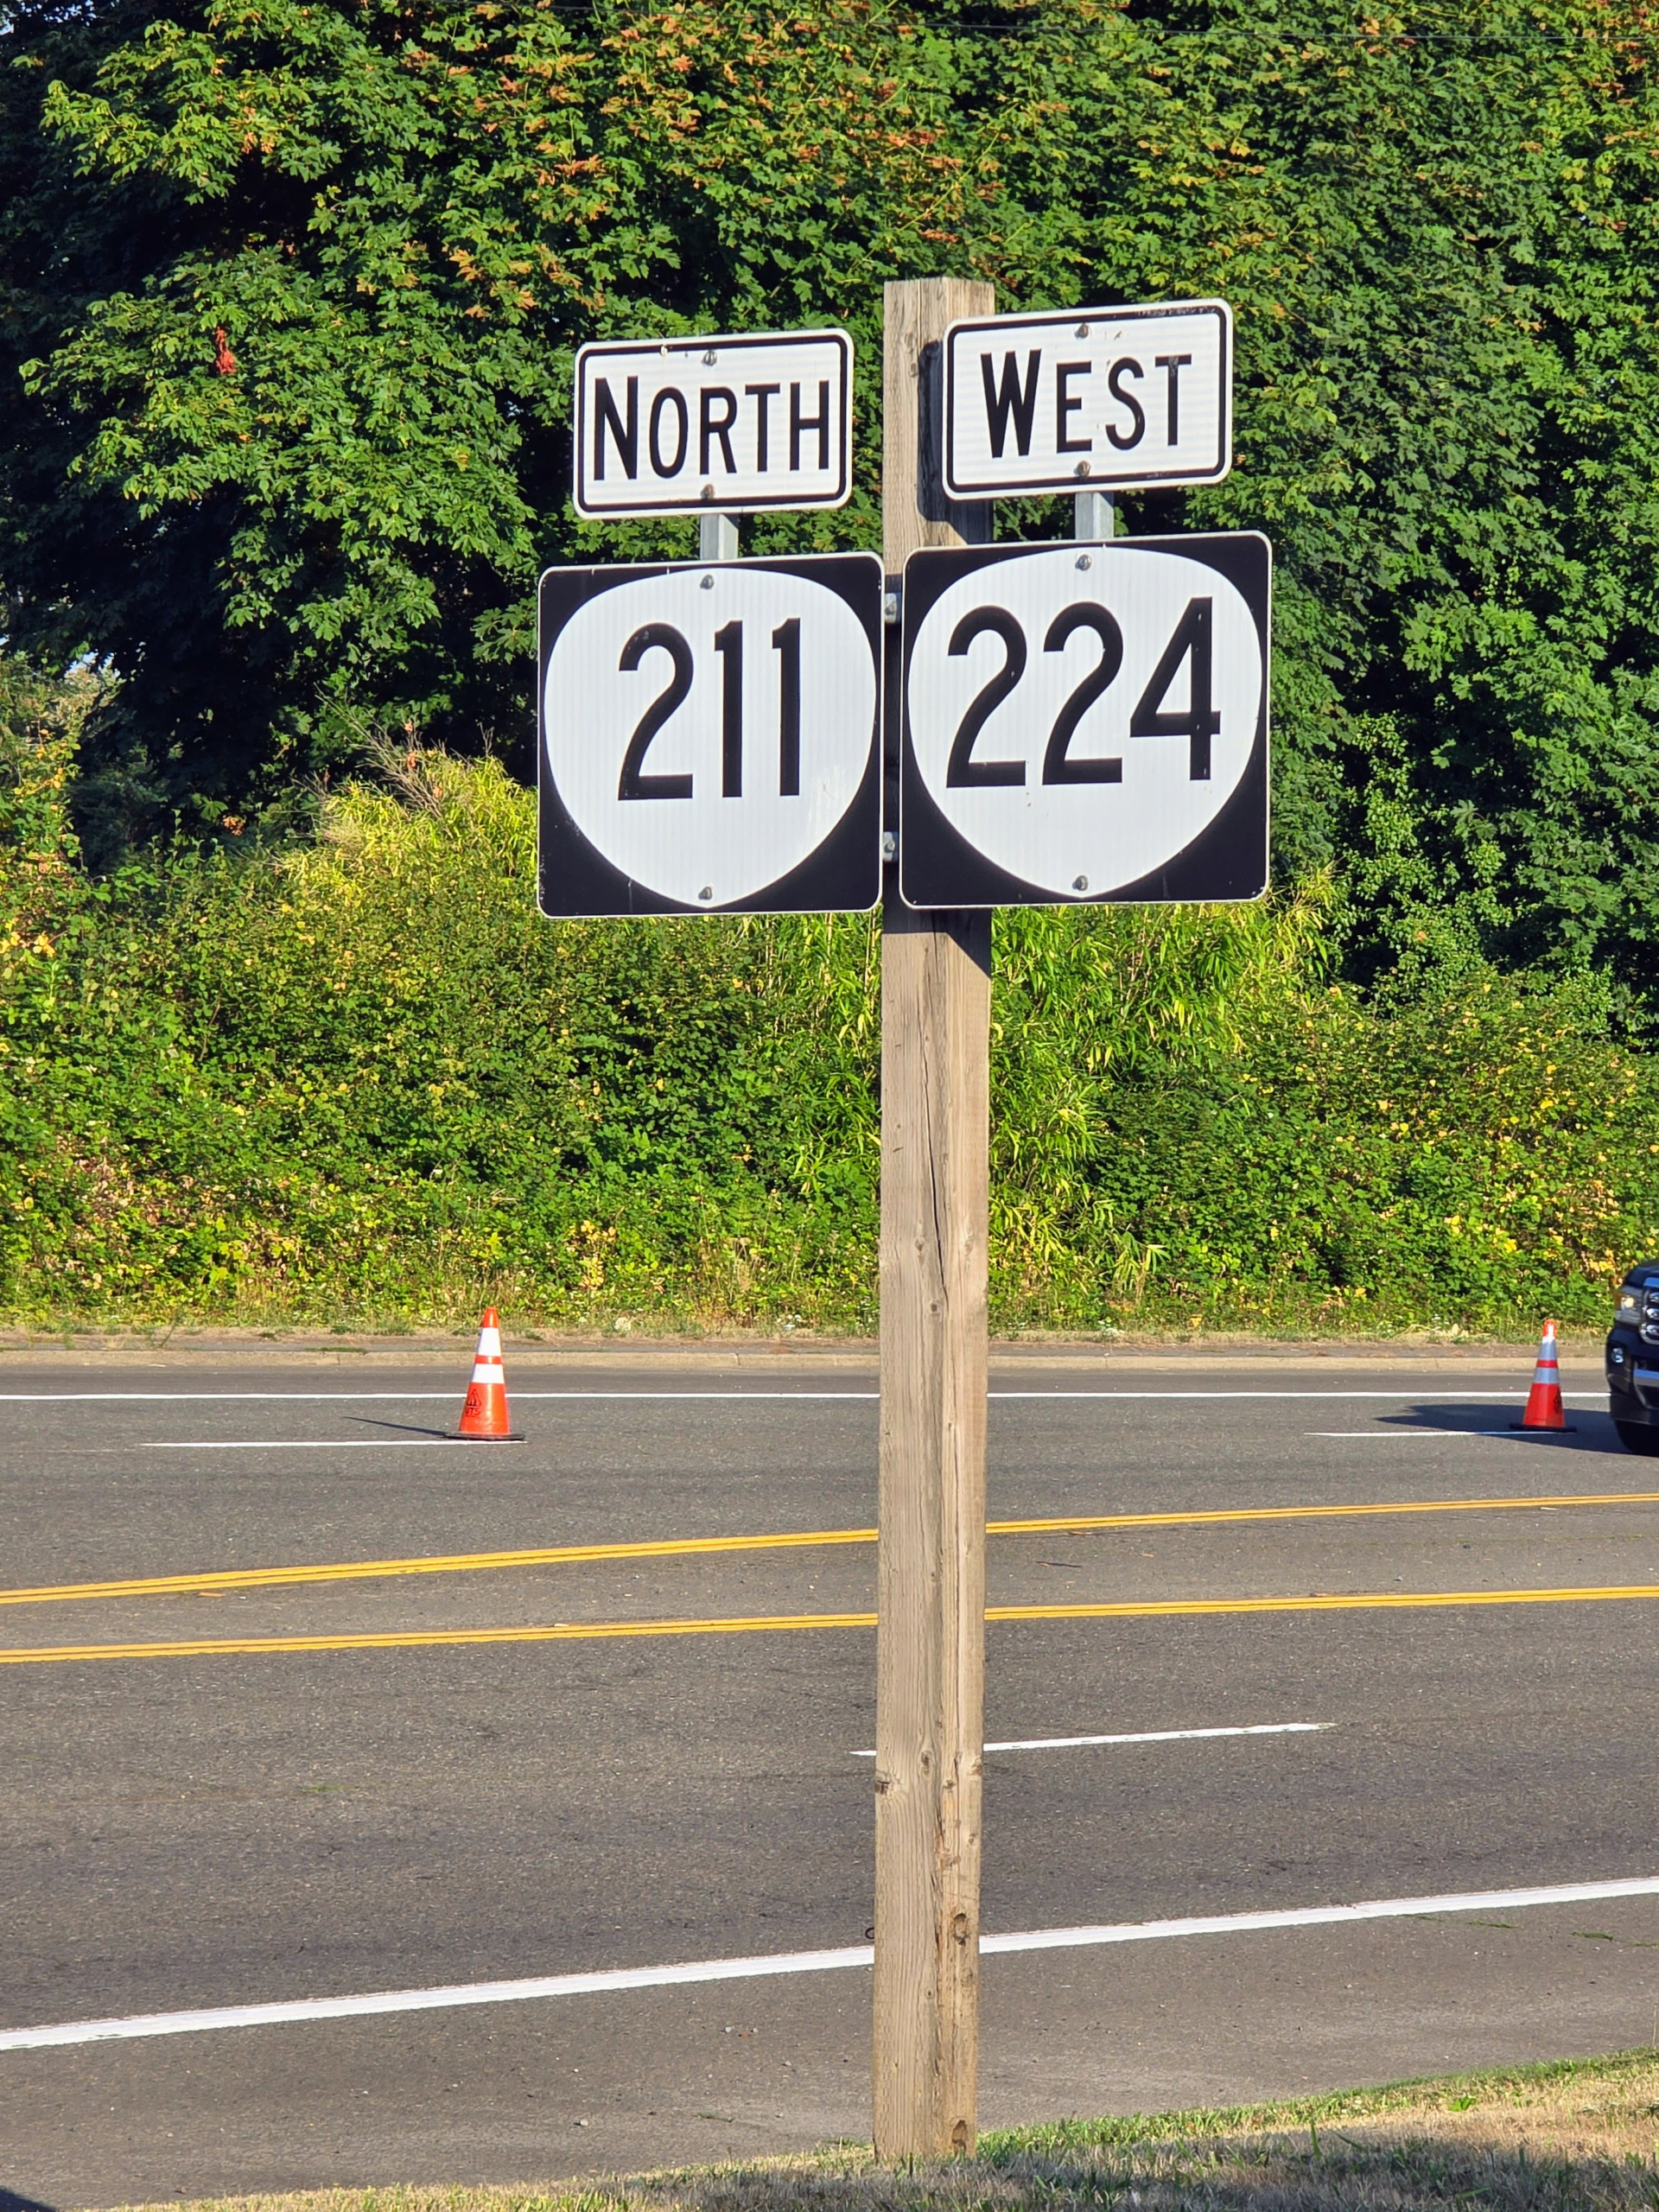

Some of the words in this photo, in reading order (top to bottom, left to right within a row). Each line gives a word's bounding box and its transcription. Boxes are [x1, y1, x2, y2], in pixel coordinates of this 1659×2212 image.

[594, 377, 830, 481] NORTH
[981, 349, 1192, 459] WEST
[619, 618, 801, 801] 211
[947, 597, 1221, 789] 224
